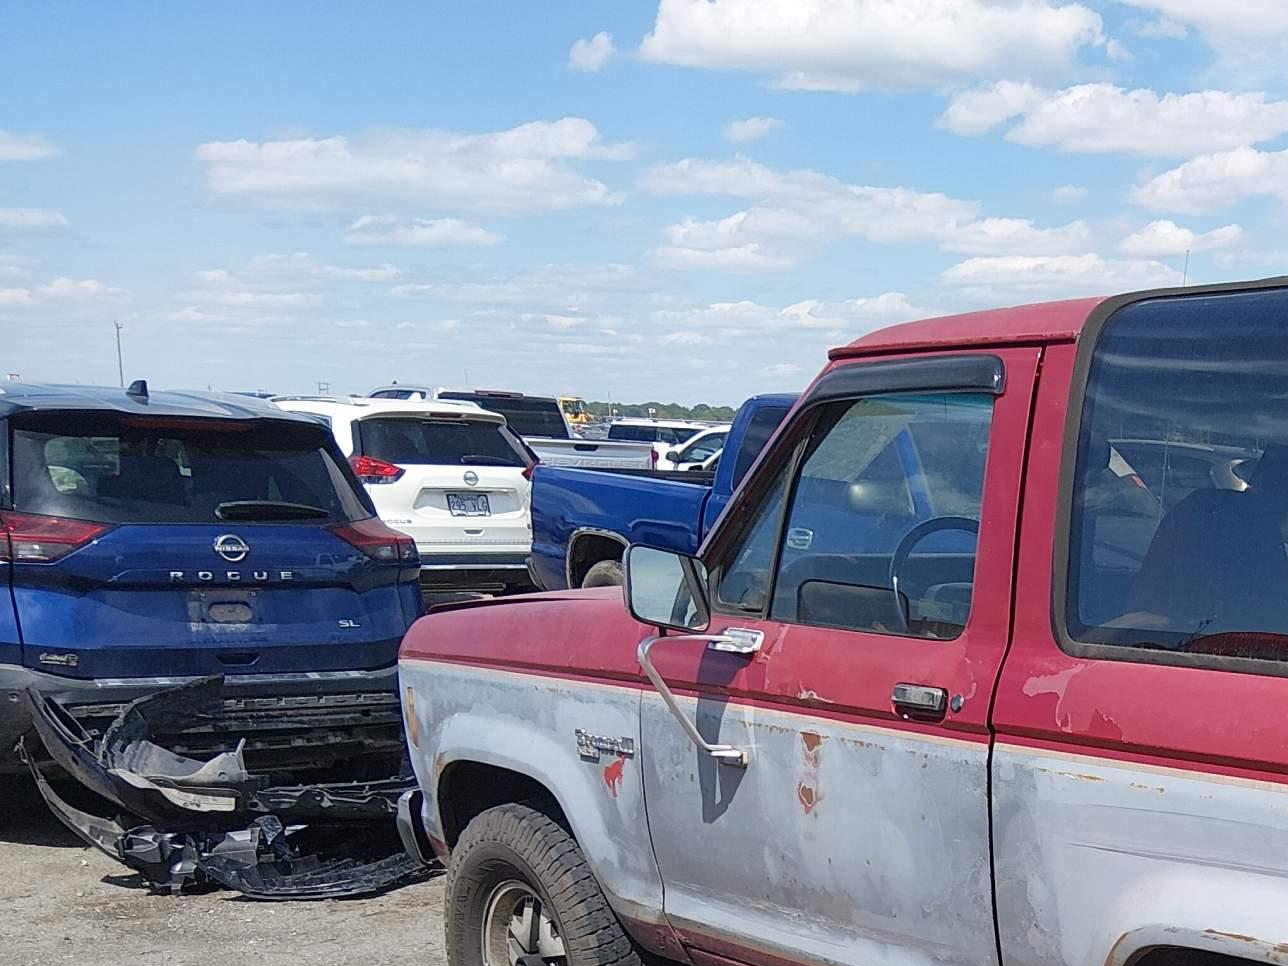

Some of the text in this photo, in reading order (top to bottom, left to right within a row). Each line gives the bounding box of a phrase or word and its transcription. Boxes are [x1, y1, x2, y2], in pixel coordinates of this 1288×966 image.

[214, 544, 250, 552] NISSAN
[169, 571, 294, 581] ROGUE
[338, 619, 361, 628] SL
